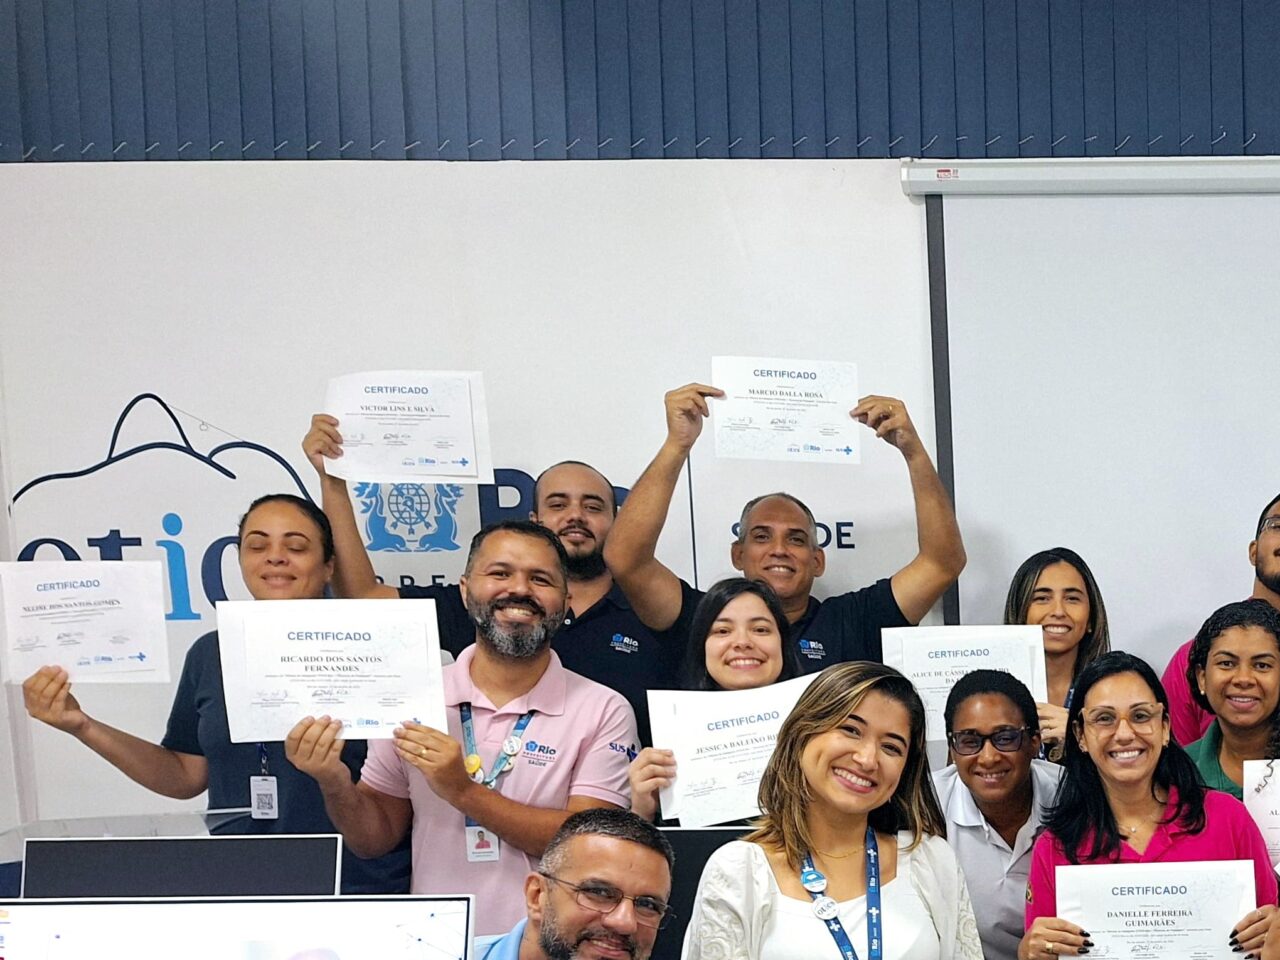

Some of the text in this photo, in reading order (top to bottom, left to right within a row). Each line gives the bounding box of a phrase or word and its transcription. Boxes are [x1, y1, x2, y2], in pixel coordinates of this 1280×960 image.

[753, 369, 817, 380] CERTIFICADO
[364, 385, 429, 395] CERTIFICADO
[748, 388, 823, 399] MARCIO DALLA ROSA
[36, 579, 101, 592] CERTIFICADO
[287, 631, 372, 642] CERTIFICADO
[623, 636, 639, 647] Rio
[809, 640, 824, 650] Rio
[928, 648, 990, 659] CERTIFICADO
[280, 655, 324, 663] RICARDO
[346, 655, 382, 664] SANTOS
[304, 664, 360, 672] FERNANDES
[707, 710, 780, 731] CERTIFICADO
[538, 745, 557, 755] Rio
[609, 742, 627, 753] SUS
[696, 743, 729, 755] JESSICA
[1111, 885, 1188, 896] CERTIFICADO
[1107, 909, 1193, 918] DANIELLE FERREIRA
[1125, 917, 1176, 927] GUIMARÃES
